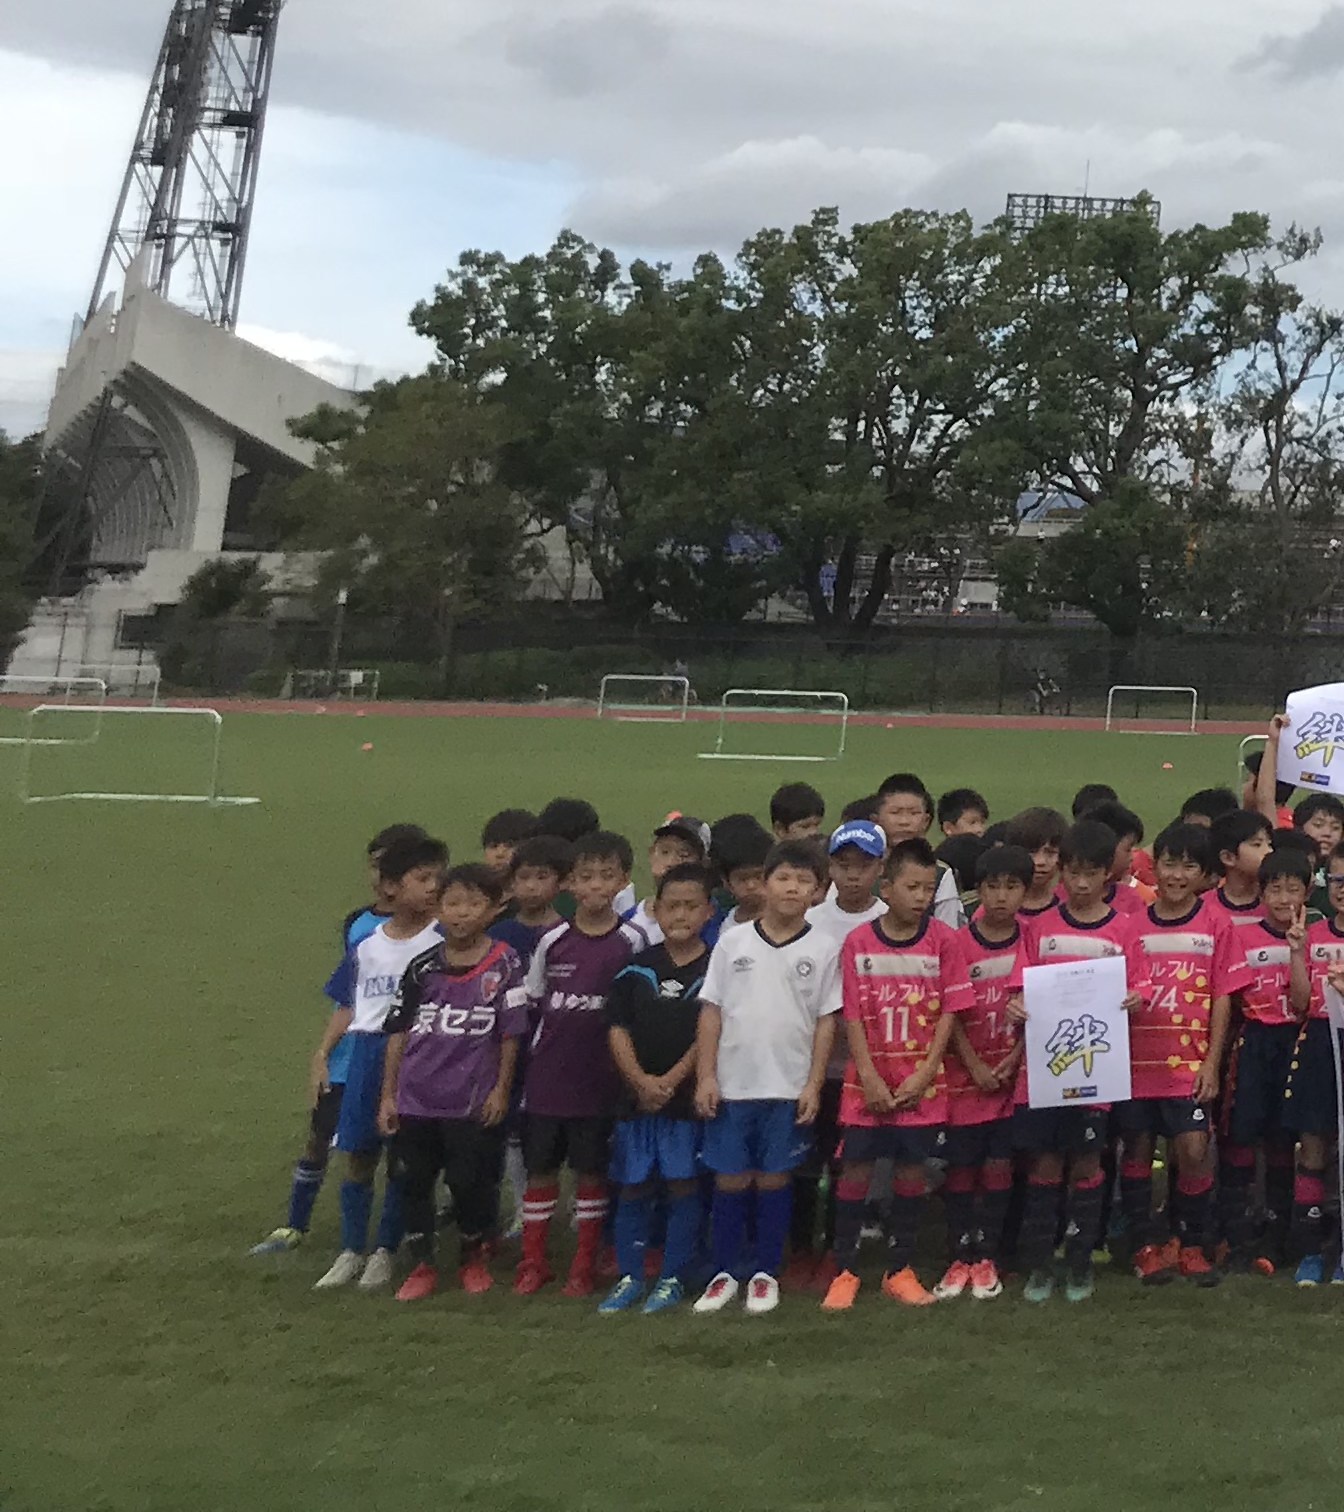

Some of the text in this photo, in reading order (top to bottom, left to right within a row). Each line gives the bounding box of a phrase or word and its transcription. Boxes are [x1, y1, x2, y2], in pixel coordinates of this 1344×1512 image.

[1147, 984, 1178, 1013] 74
[410, 1001, 497, 1036] 京セラ
[879, 1005, 910, 1043] 11
[1045, 1014, 1111, 1078] 絆
